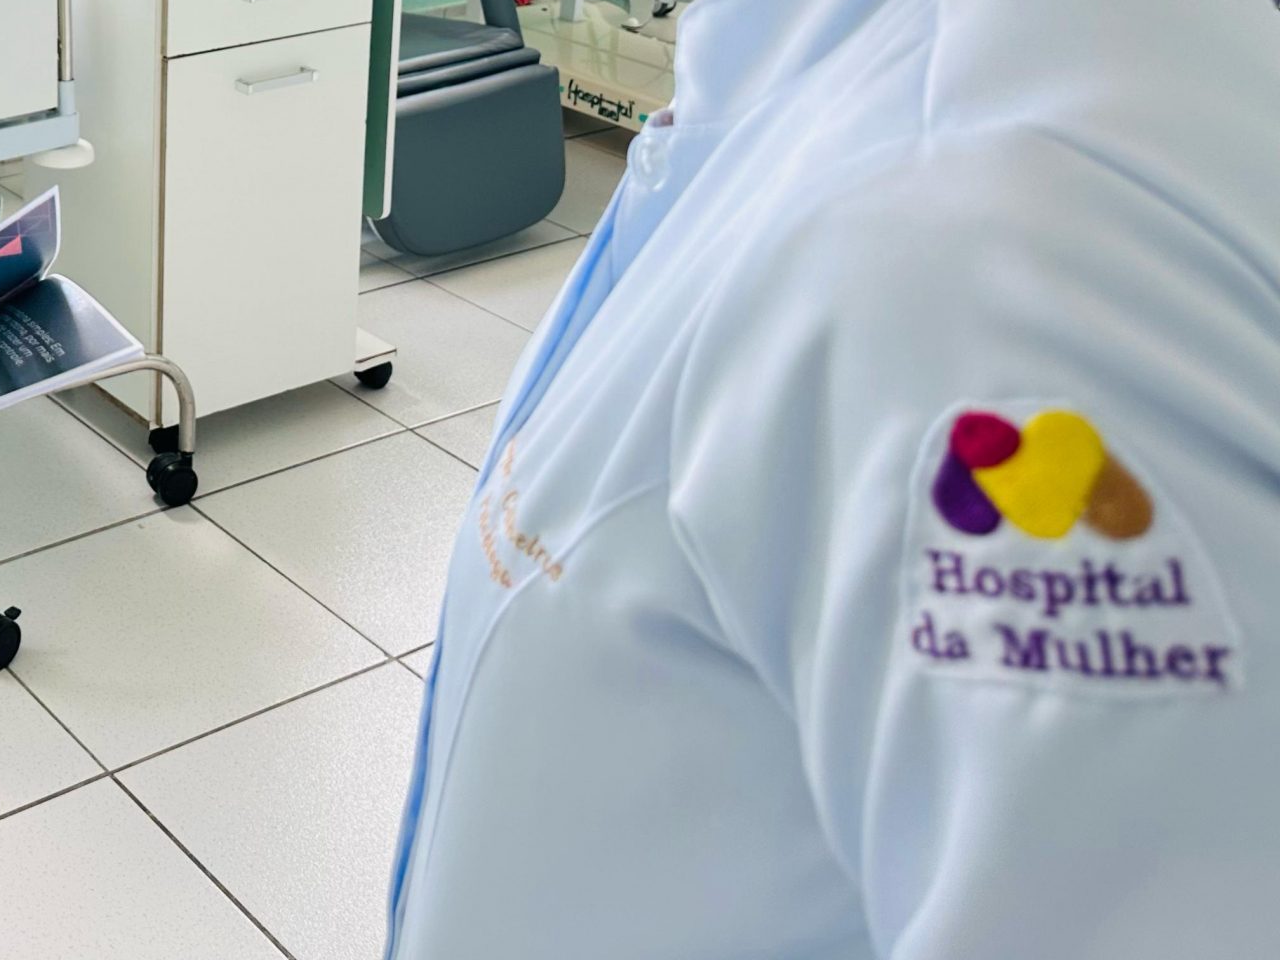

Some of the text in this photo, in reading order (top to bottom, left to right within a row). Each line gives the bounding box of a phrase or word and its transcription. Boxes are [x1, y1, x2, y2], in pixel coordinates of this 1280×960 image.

[926, 550, 1191, 618] Hospital
[912, 611, 1233, 686] da Mulher
